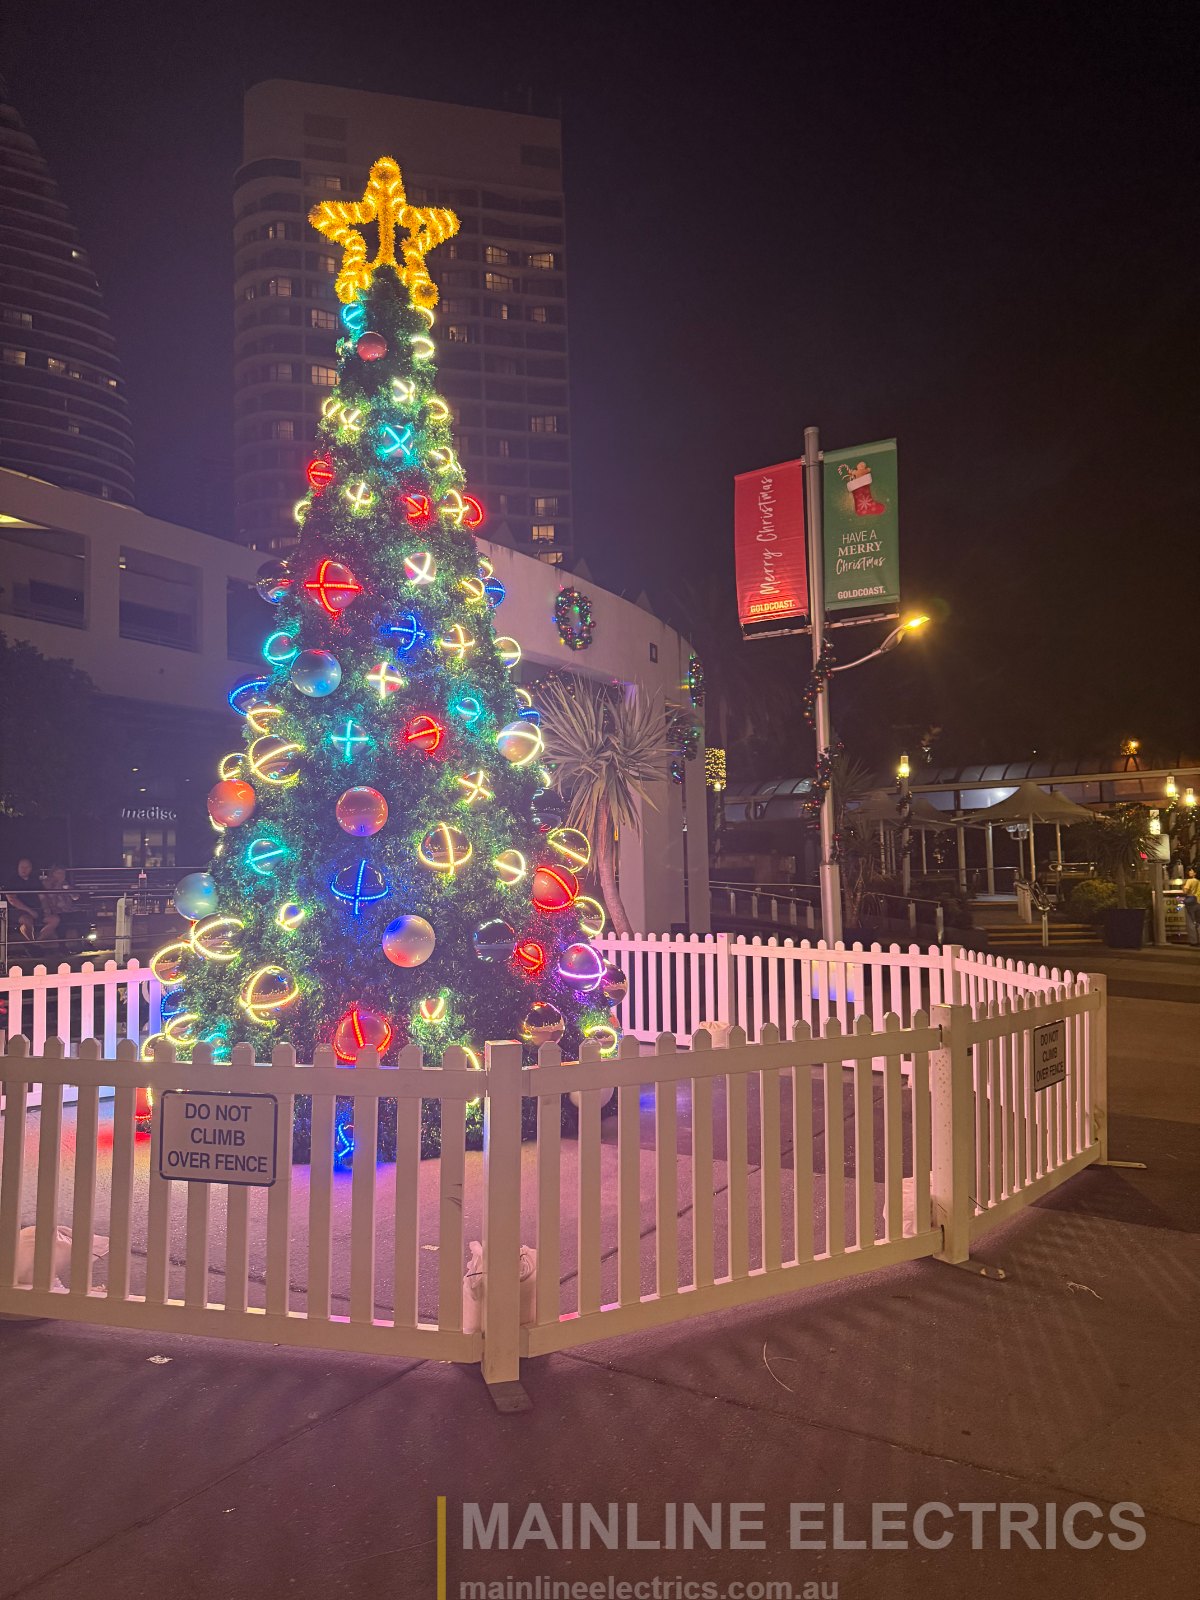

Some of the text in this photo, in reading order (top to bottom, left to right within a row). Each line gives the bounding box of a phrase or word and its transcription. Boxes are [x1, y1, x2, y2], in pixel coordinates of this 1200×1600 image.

[756, 476, 783, 595] Merry Christmas
[842, 529, 877, 544] HAVE A
[838, 541, 883, 557] MERRY
[836, 556, 886, 576] Christmas
[1040, 1030, 1059, 1046] DO NOT
[1042, 1047, 1058, 1062] CLIMB
[1036, 1062, 1064, 1081] OVER FENCE
[184, 1103, 252, 1122] DO NOT
[190, 1128, 245, 1146] CLIMB
[167, 1151, 268, 1173] OVER FENCE
